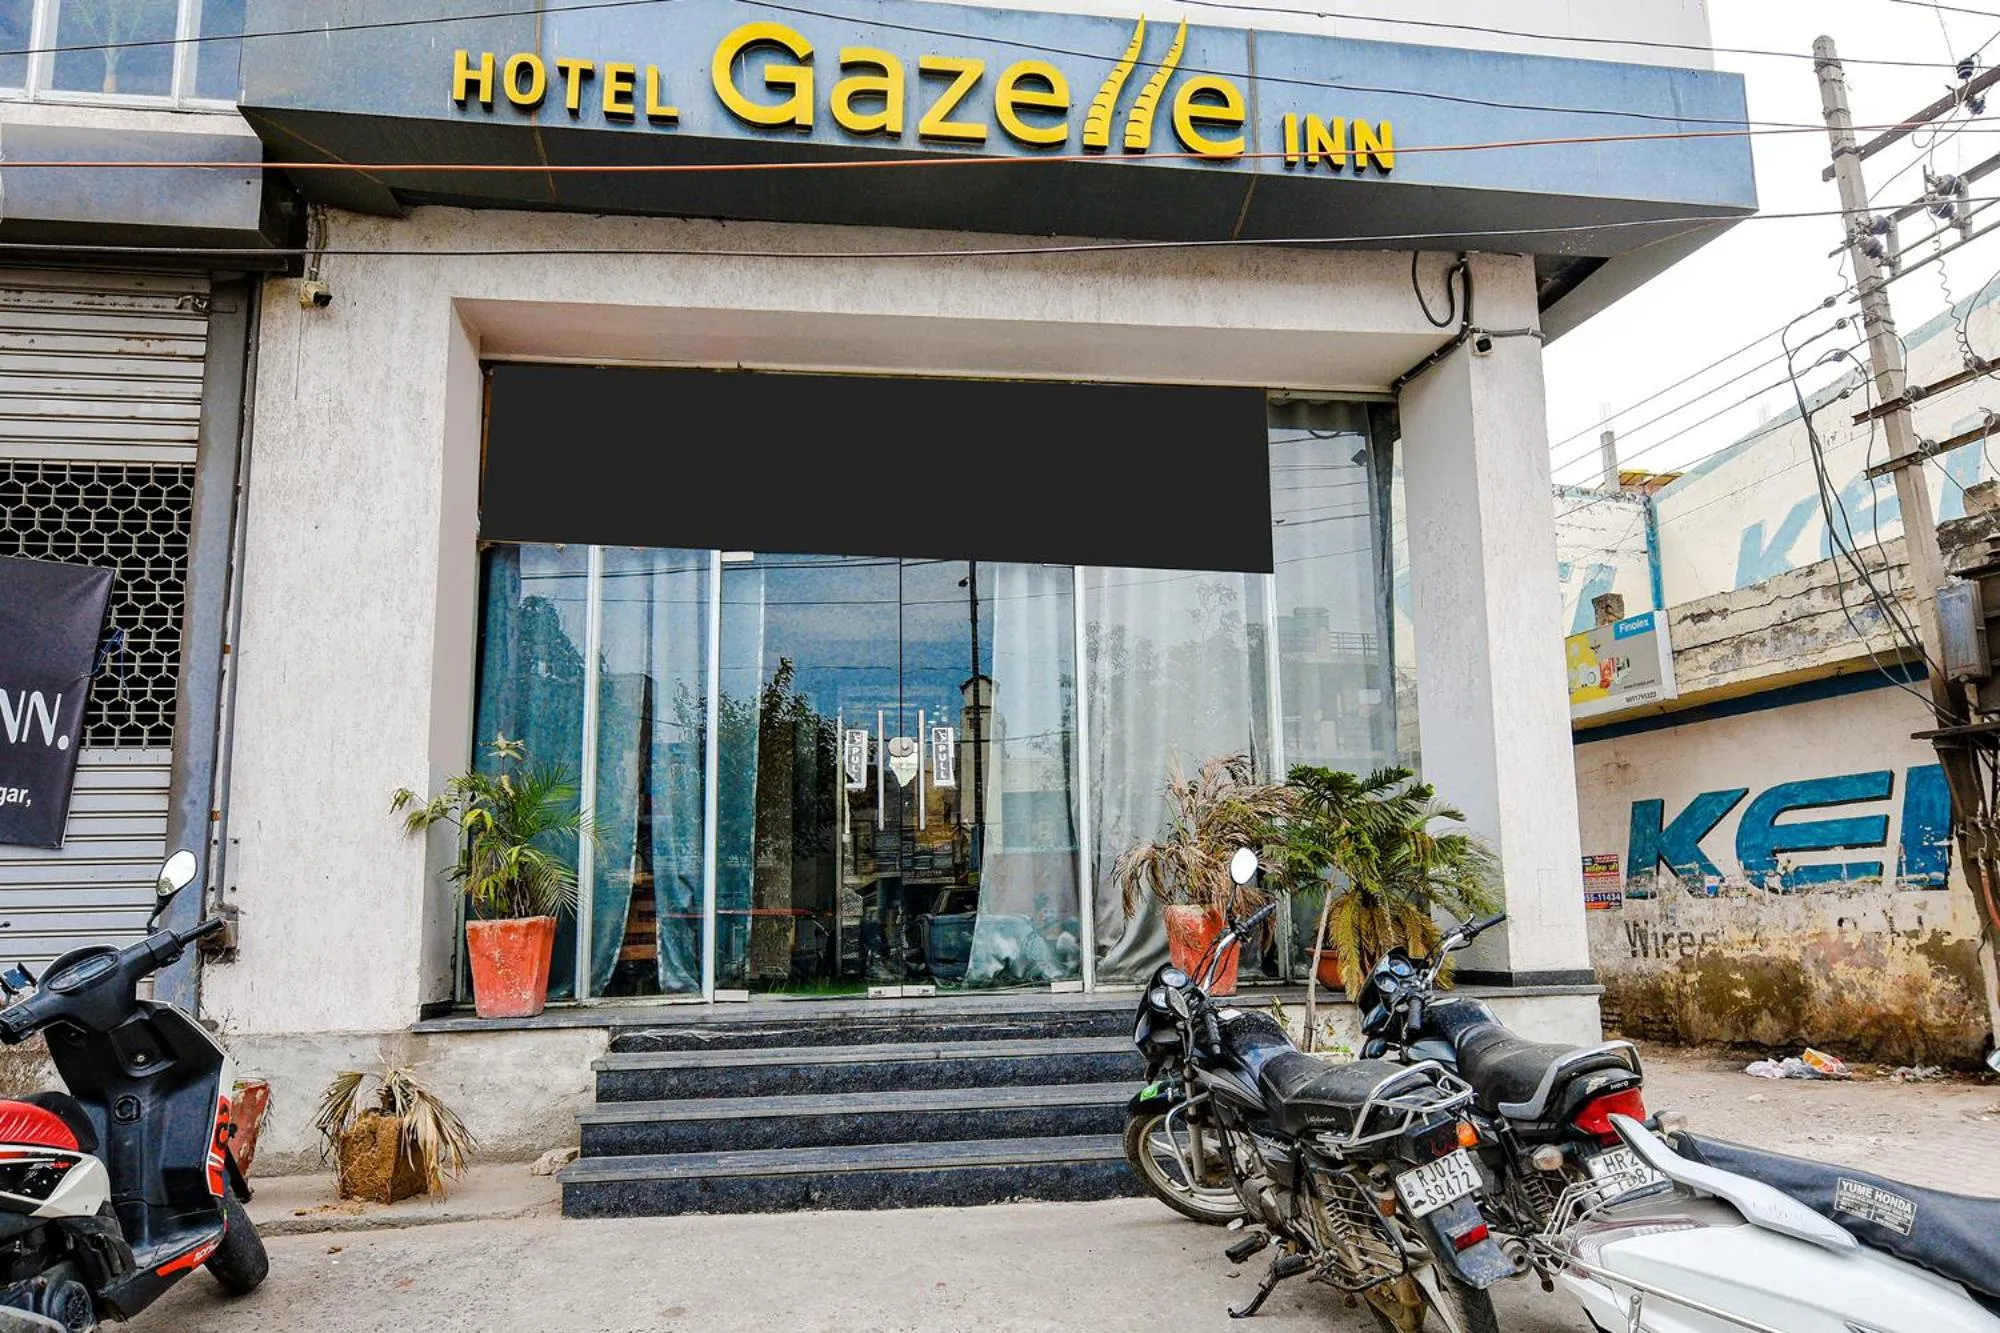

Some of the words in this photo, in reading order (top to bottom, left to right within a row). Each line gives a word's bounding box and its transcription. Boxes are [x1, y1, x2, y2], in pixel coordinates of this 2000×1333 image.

[452, 49, 679, 126] HOTEL
[711, 12, 1245, 161] Gazelle
[1283, 112, 1395, 174] INN
[1619, 617, 1649, 633] Finolex
[937, 743, 948, 779] PULL
[1624, 764, 1953, 900] KEI
[1602, 1149, 1638, 1173] HR2
[1841, 1180, 1874, 1198] YUME
[1874, 1190, 1913, 1214] HONDA
